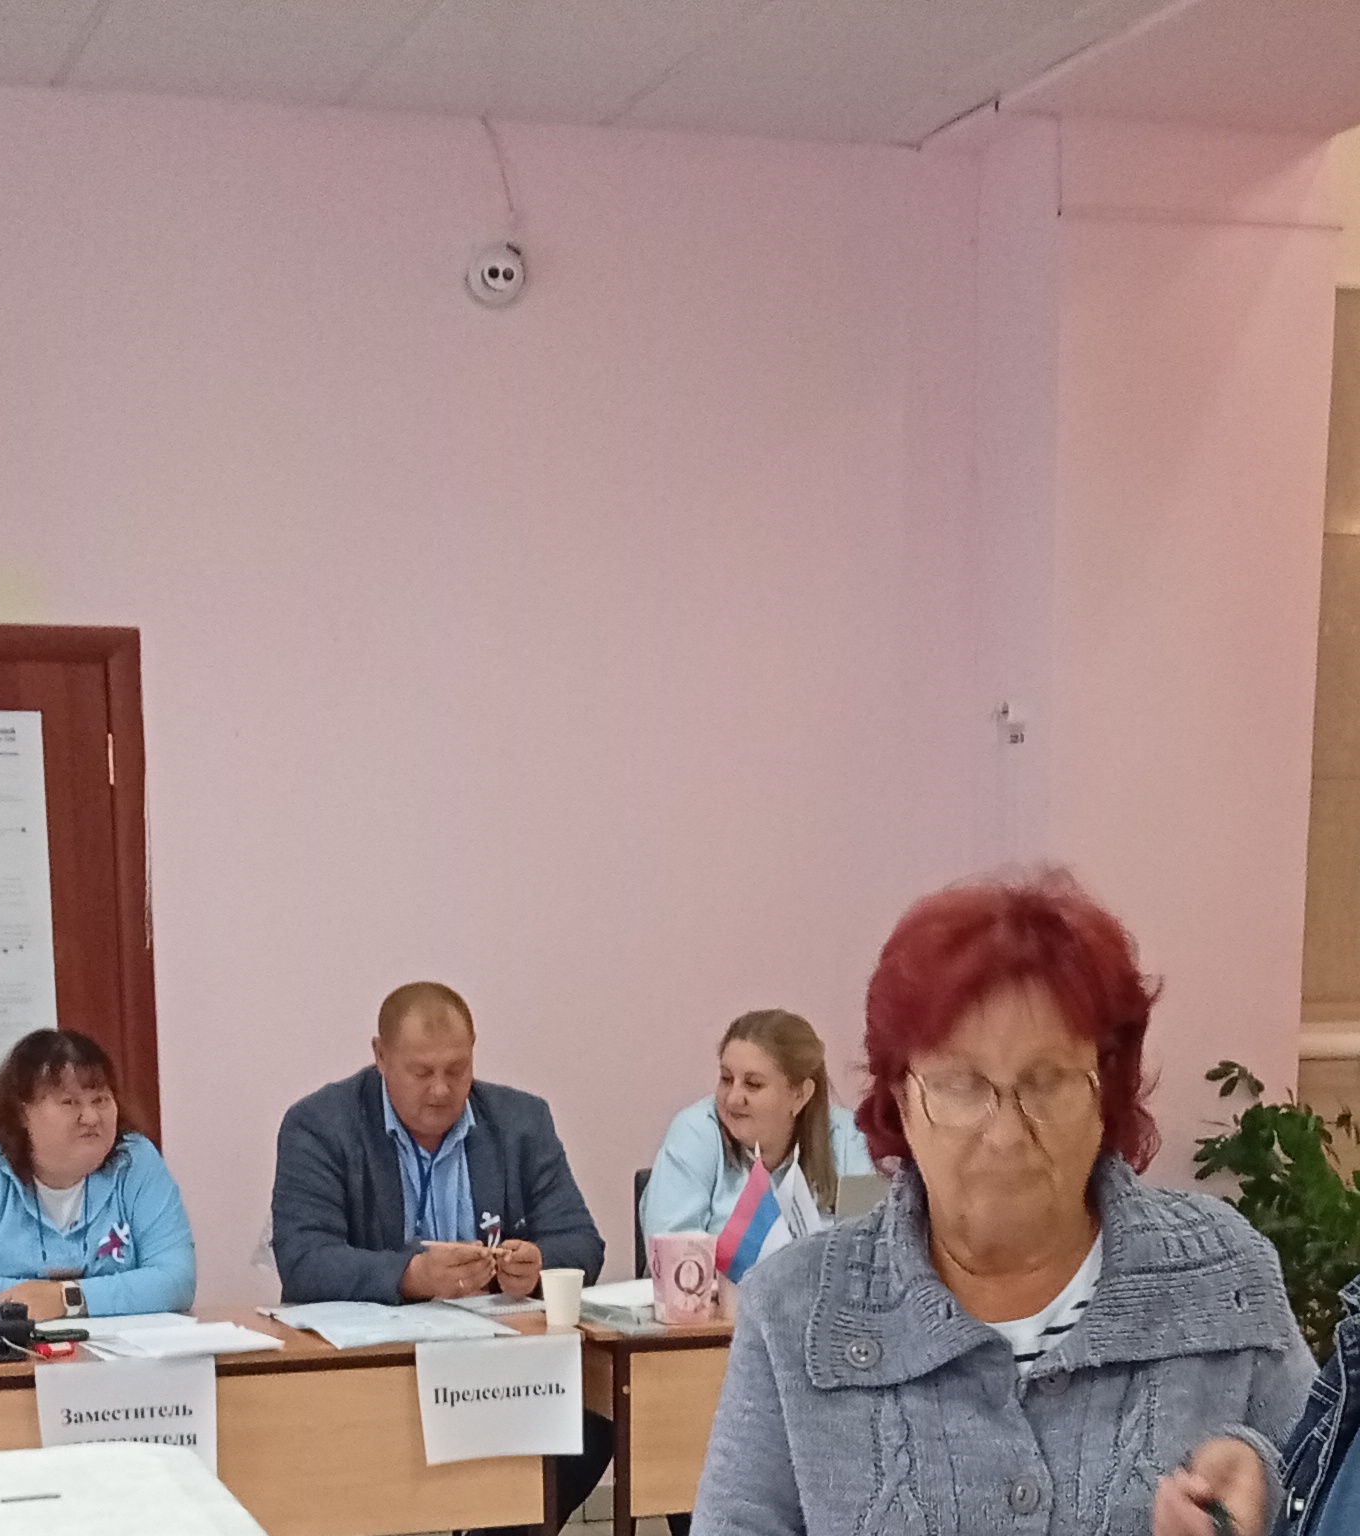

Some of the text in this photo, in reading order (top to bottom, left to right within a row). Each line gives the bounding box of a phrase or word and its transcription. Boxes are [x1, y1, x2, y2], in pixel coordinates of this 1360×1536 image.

[673, 1259, 708, 1297] Q
[433, 1381, 566, 1408] Председатель
[60, 1403, 193, 1425] Заместитель
